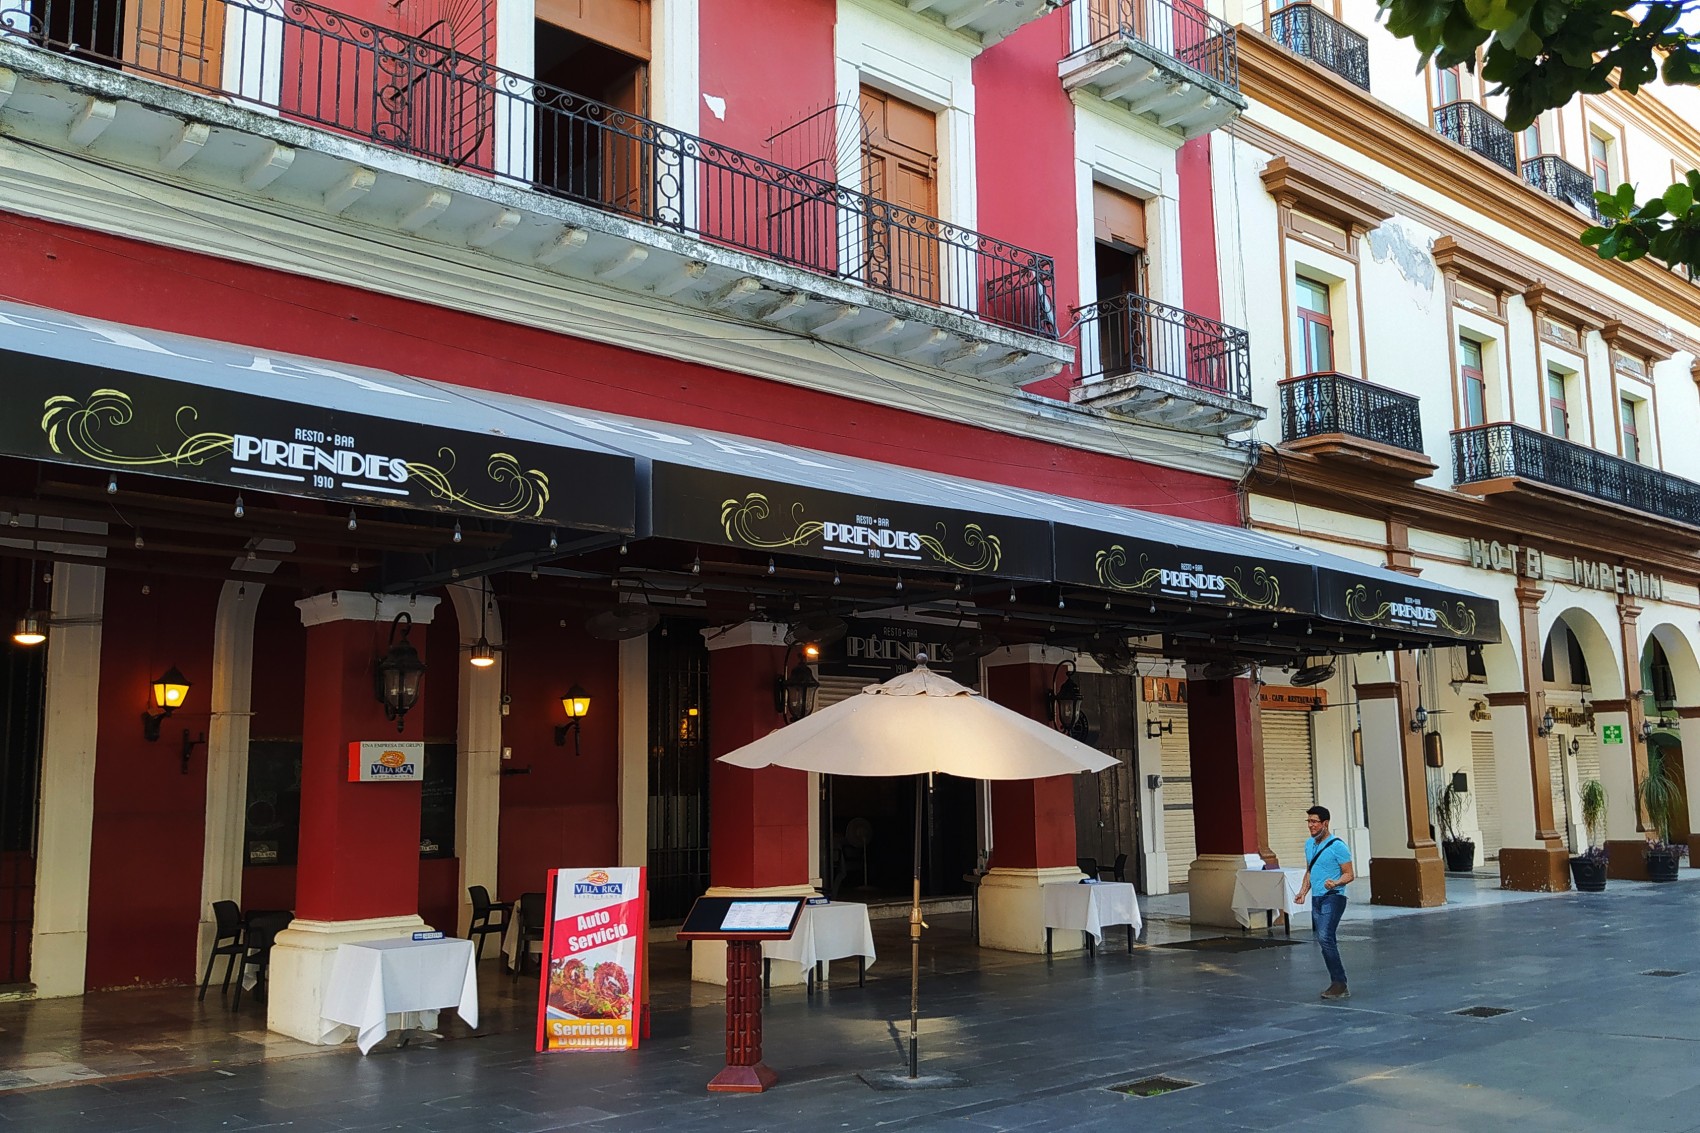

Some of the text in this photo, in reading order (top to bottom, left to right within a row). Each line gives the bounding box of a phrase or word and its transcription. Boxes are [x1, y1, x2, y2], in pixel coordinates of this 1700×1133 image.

[295, 428, 355, 448] RESTO BAR
[233, 434, 410, 483] PRENDES
[313, 474, 334, 489] 1910
[856, 514, 890, 527] RESTO BAR
[823, 521, 921, 551] PRENDES
[867, 548, 881, 559] 1910
[1470, 537, 1669, 601] HOTEL IMPERIAL
[1160, 569, 1225, 591] PRENDES
[1390, 602, 1437, 621] PRENDES
[883, 626, 918, 638] RESTO BAR
[847, 636, 954, 663] PRENDES
[372, 764, 413, 773] VILLA RICA
[575, 884, 621, 893] VILLA RICA
[577, 911, 610, 931] Auto
[568, 923, 628, 952] Servicio
[553, 1022, 626, 1036] Servicio a
